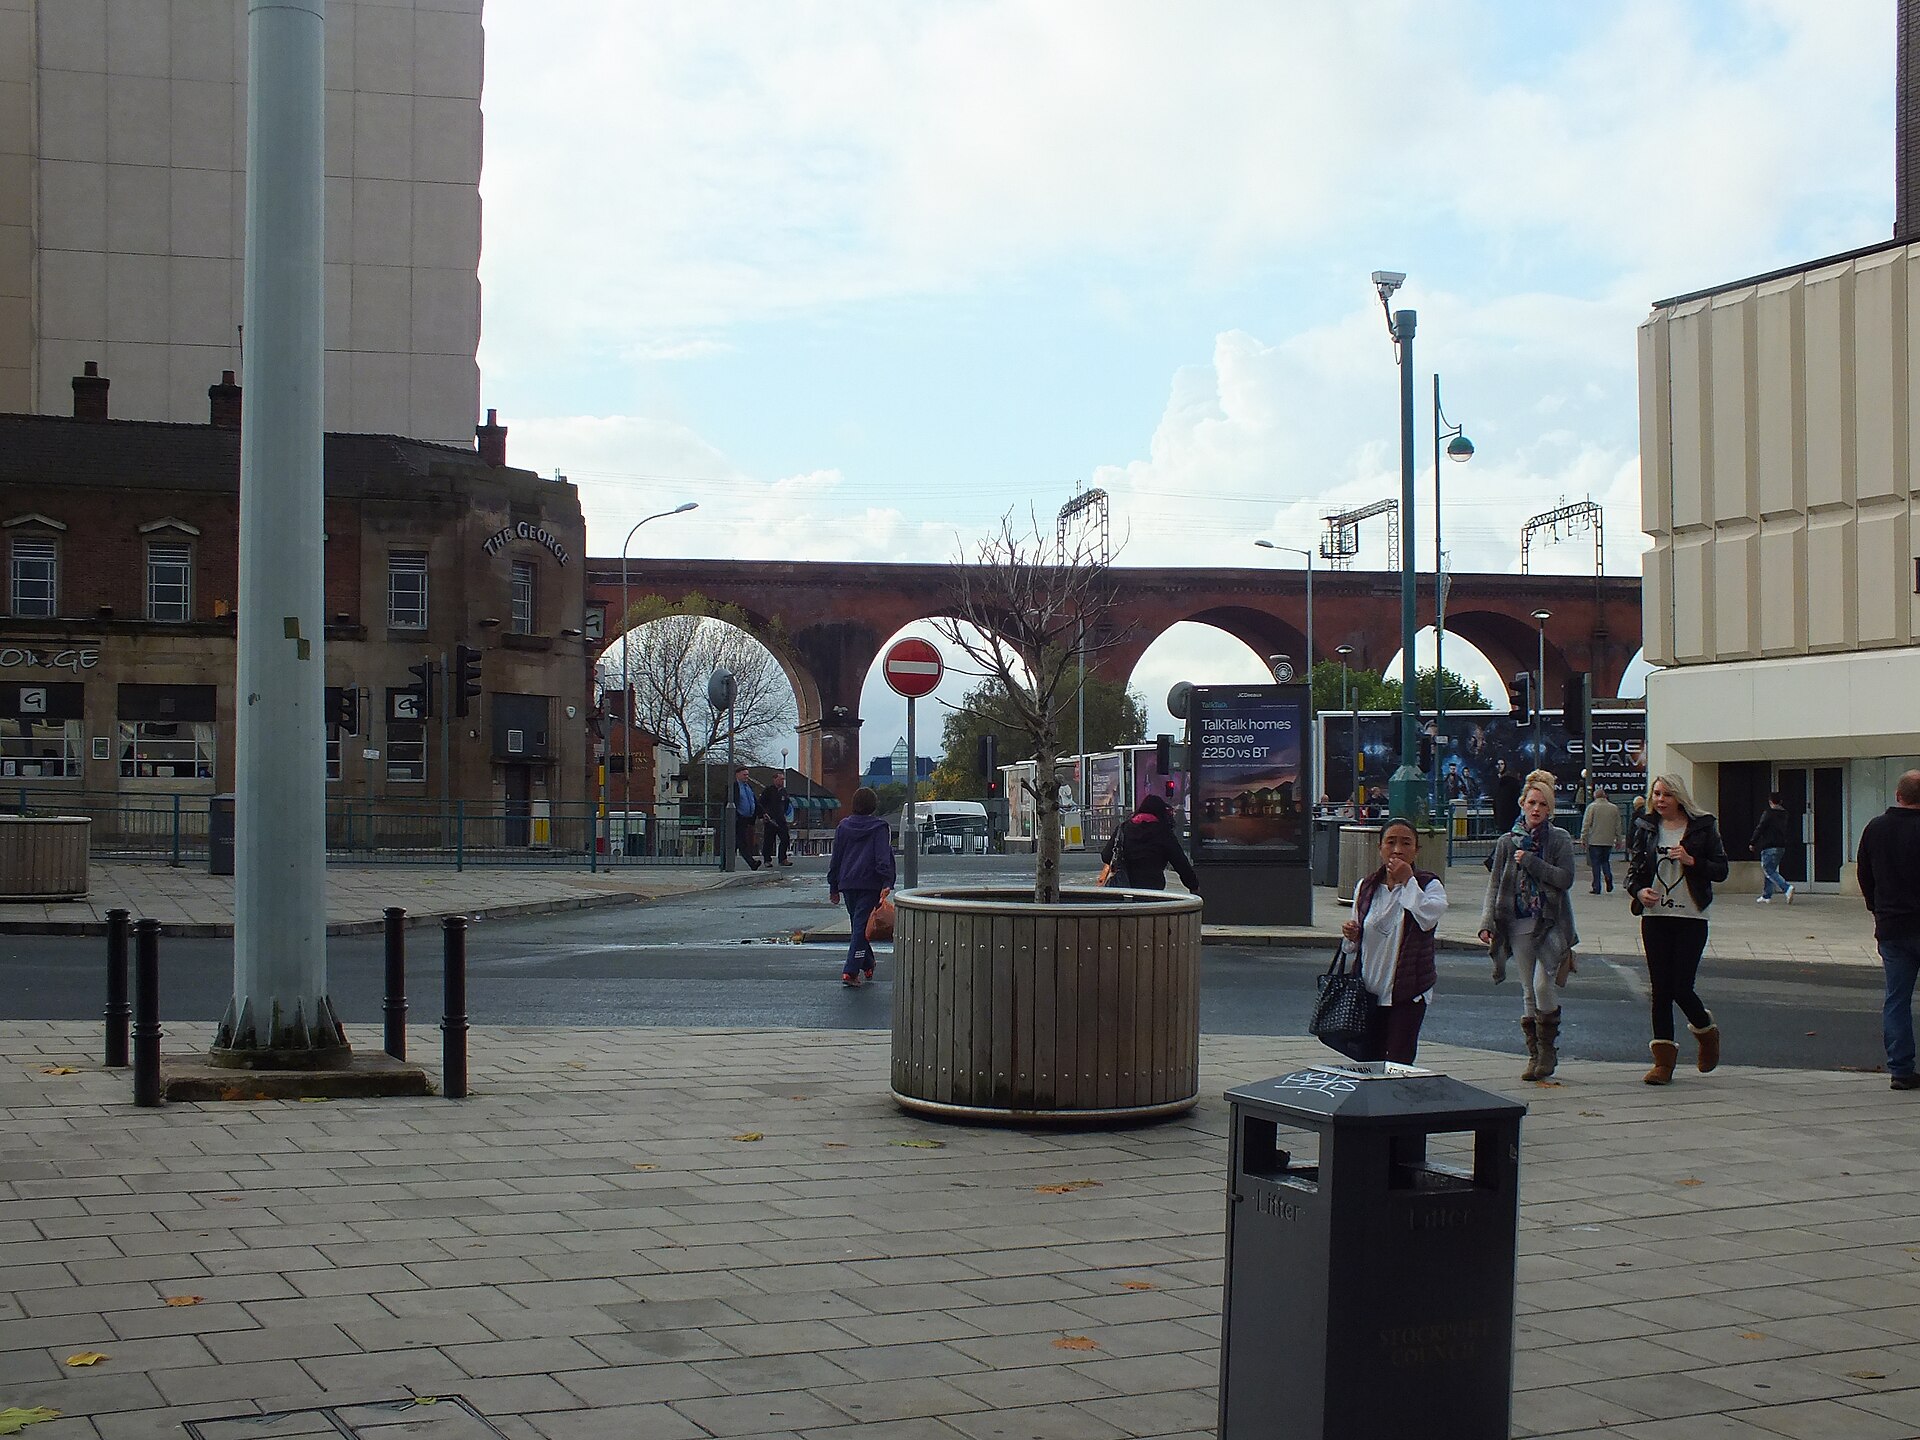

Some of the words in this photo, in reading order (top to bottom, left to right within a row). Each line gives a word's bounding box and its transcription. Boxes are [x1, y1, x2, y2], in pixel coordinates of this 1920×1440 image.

[483, 527, 513, 558] THE
[516, 521, 570, 566] GEORGE
[1201, 718, 1247, 731] TalkTalk
[1249, 718, 1292, 730] homes
[1202, 734, 1225, 744] can
[1226, 734, 1255, 744] save
[1202, 746, 1236, 759] £250
[1236, 749, 1250, 758] vs
[1252, 746, 1270, 758] BT
[1566, 739, 1646, 753] ENDE
[1622, 783, 1646, 791] OCT
[1255, 1188, 1301, 1223] Litter
[1409, 1206, 1473, 1232] Litter
